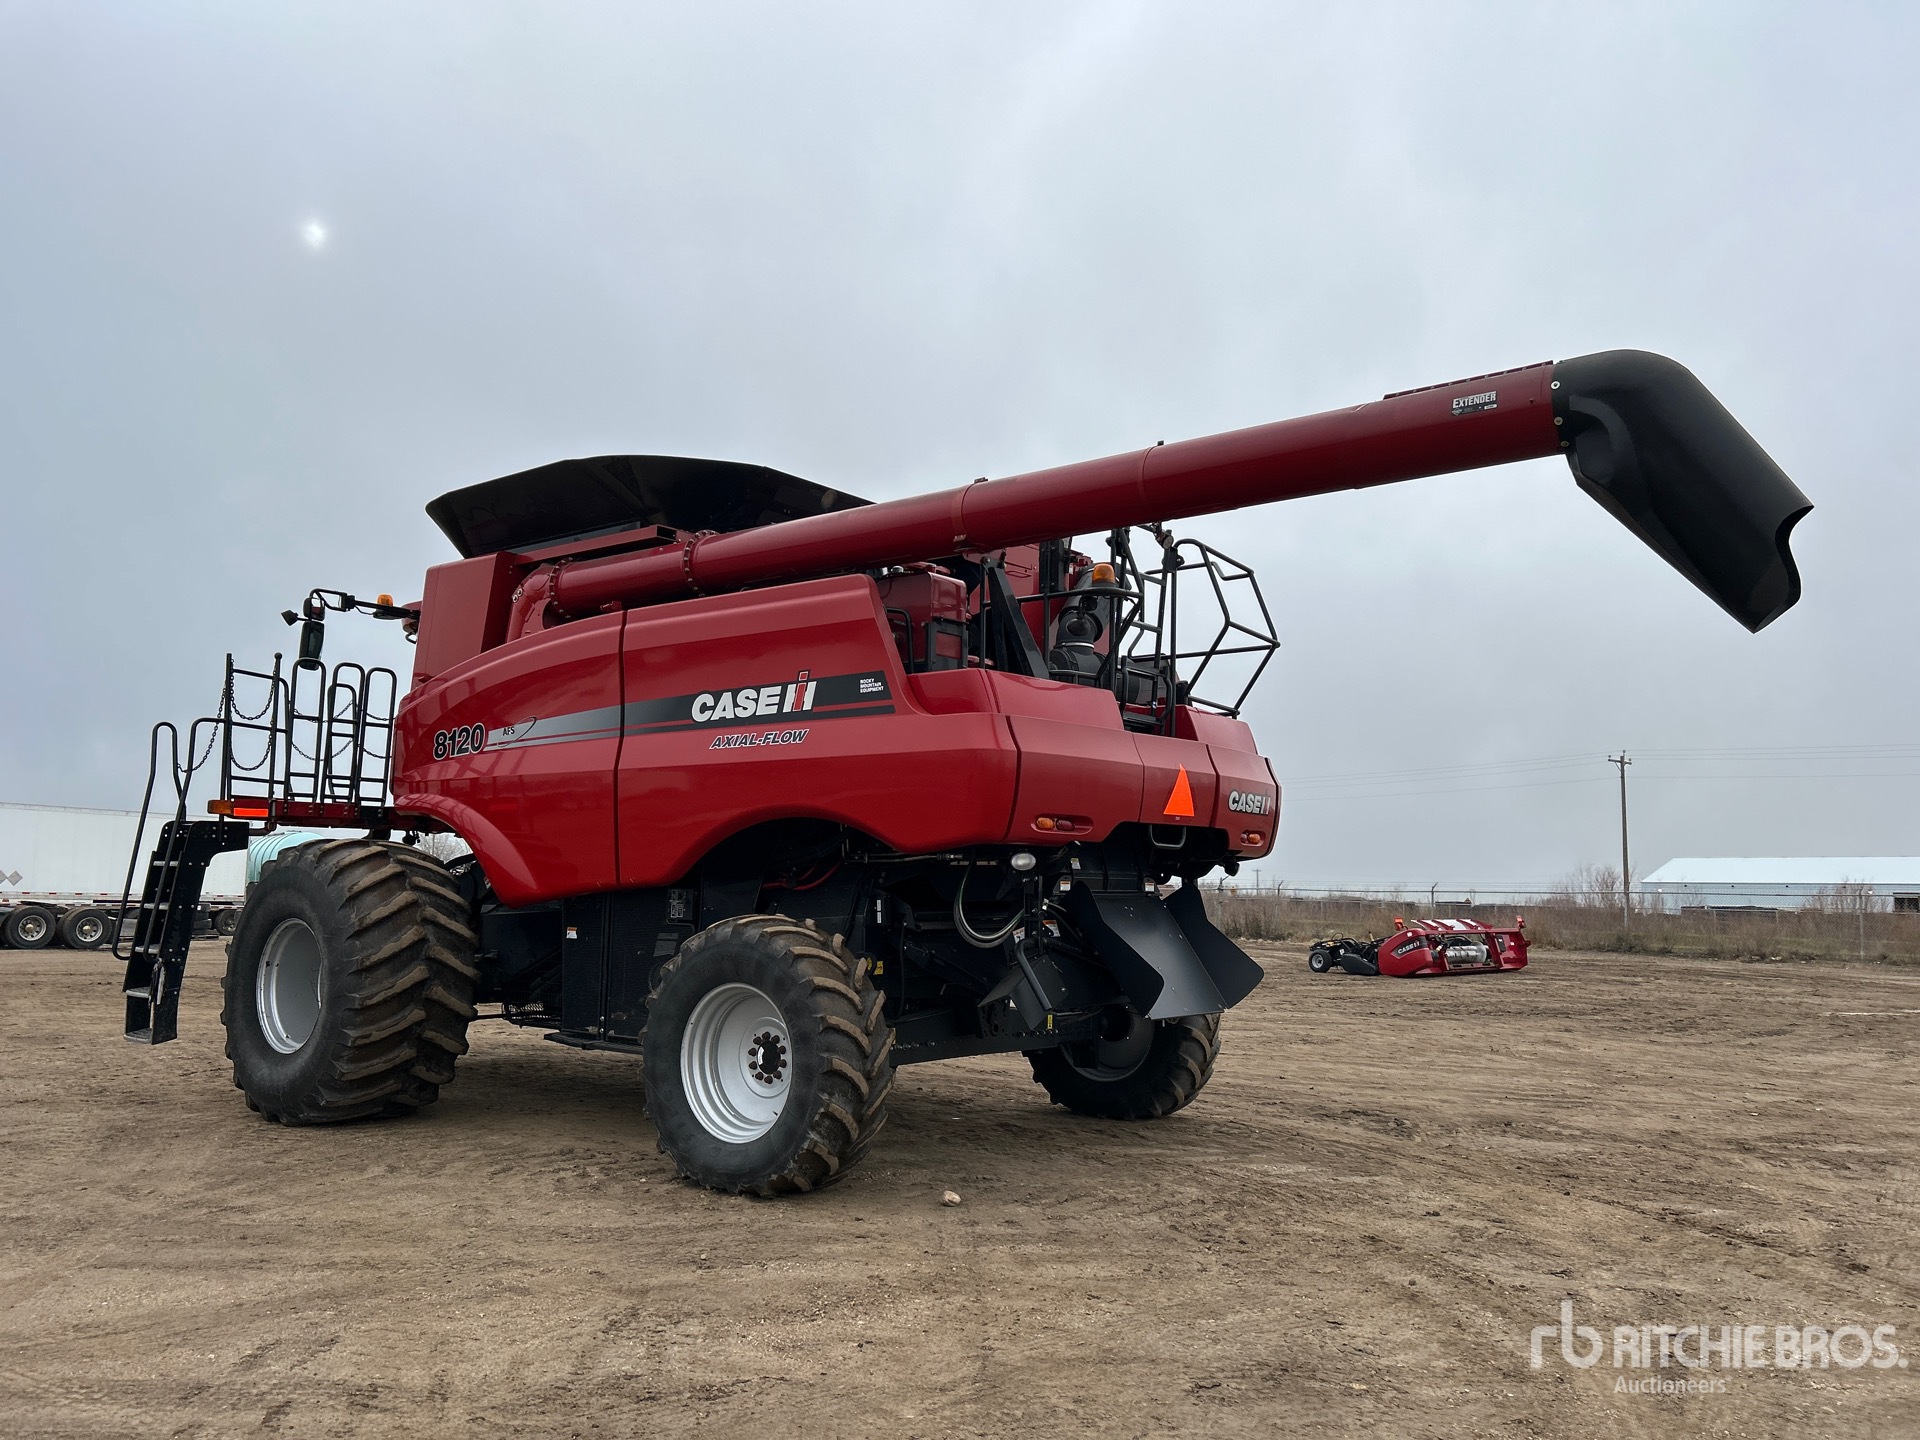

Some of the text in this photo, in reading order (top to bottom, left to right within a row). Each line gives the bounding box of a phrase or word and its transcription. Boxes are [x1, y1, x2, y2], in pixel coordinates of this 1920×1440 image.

[1452, 393, 1497, 409] EXTENDER
[433, 722, 486, 760] 8120
[502, 726, 515, 737] AFS
[708, 728, 810, 750] AXIAL-FLOW
